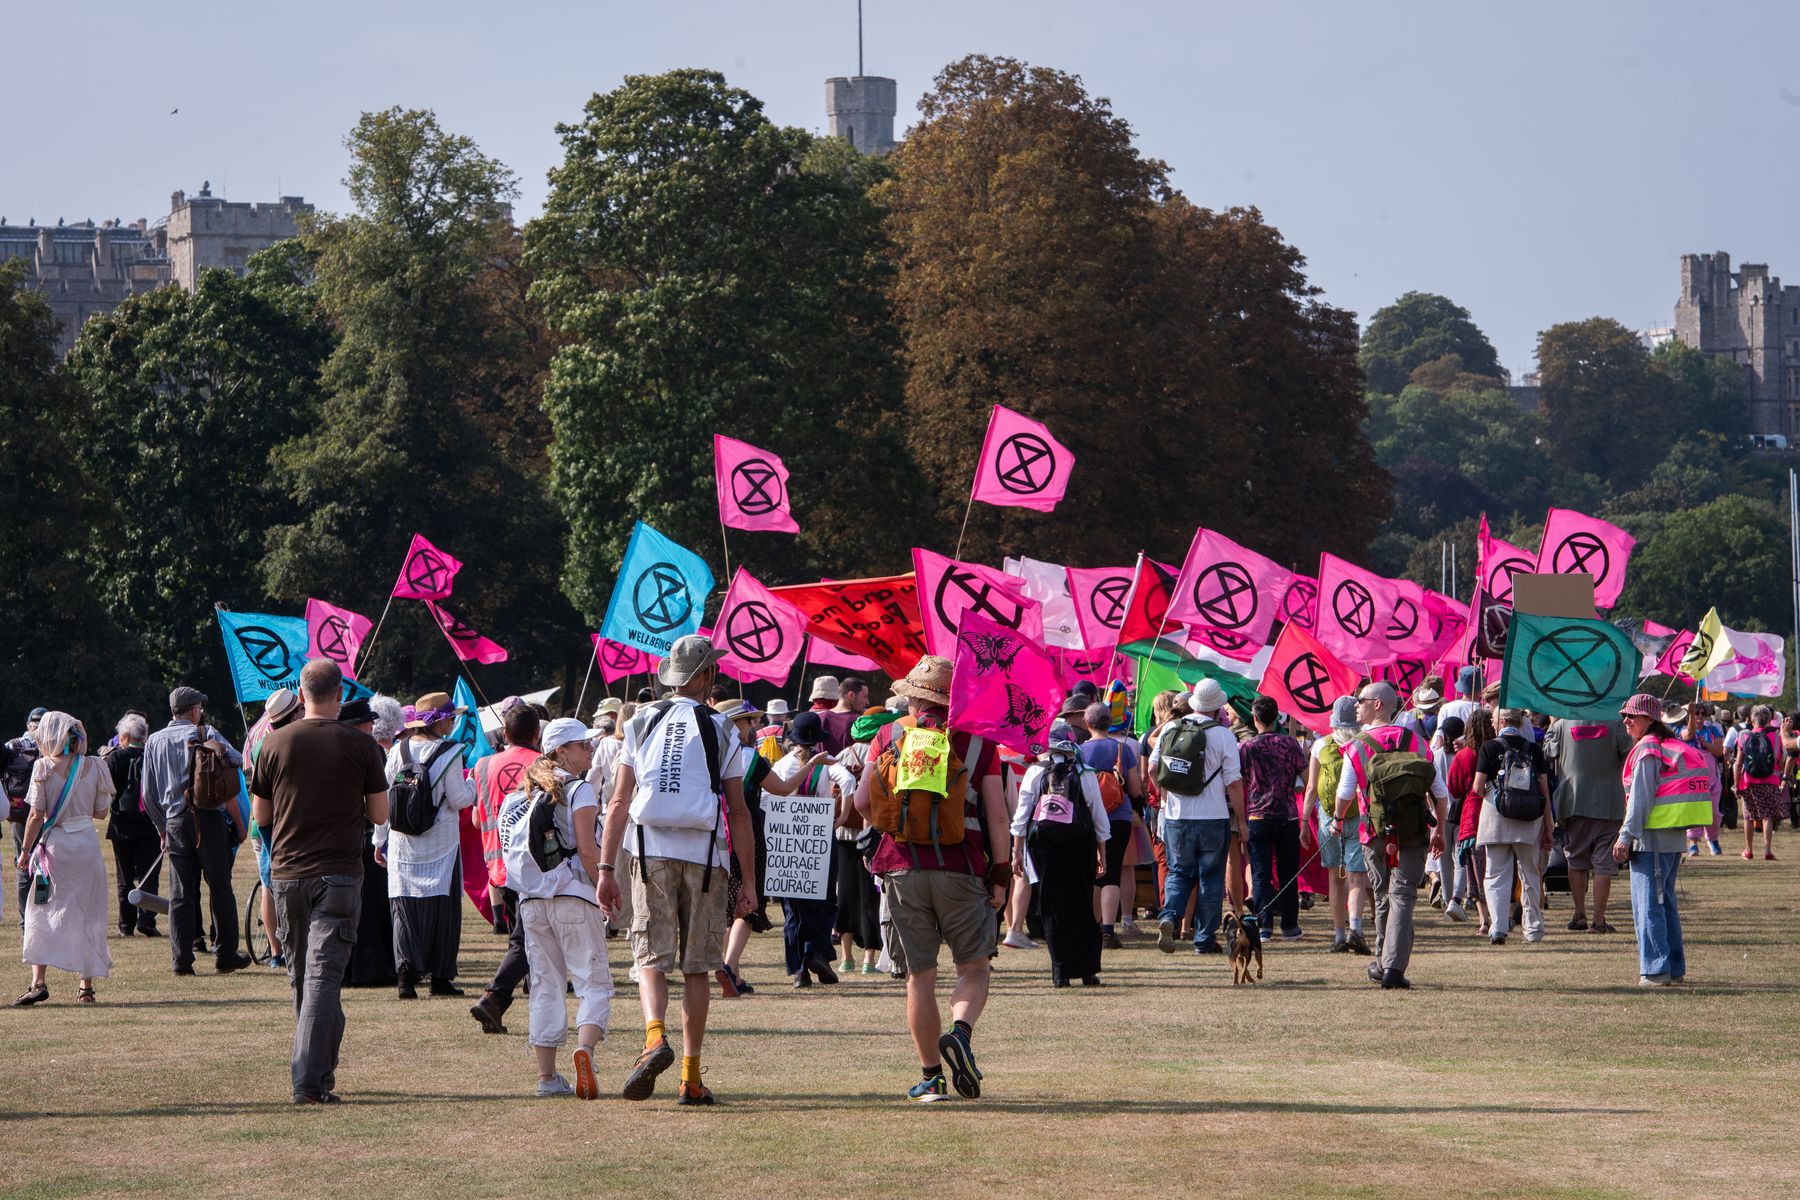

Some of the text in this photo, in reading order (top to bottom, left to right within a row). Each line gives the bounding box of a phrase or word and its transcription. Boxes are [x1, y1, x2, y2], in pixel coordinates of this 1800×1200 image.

[659, 722, 675, 792] AND DEESCALATION
[669, 722, 686, 793] NONVIOLENCE
[771, 801, 831, 815] WE CANNOT
[792, 815, 809, 823] AND
[769, 822, 826, 837] WILL NOT BE
[766, 836, 828, 855] SILENCED
[767, 855, 821, 870] COURAGE
[778, 869, 810, 879] CALLS TO
[765, 877, 819, 894] COURAGE
